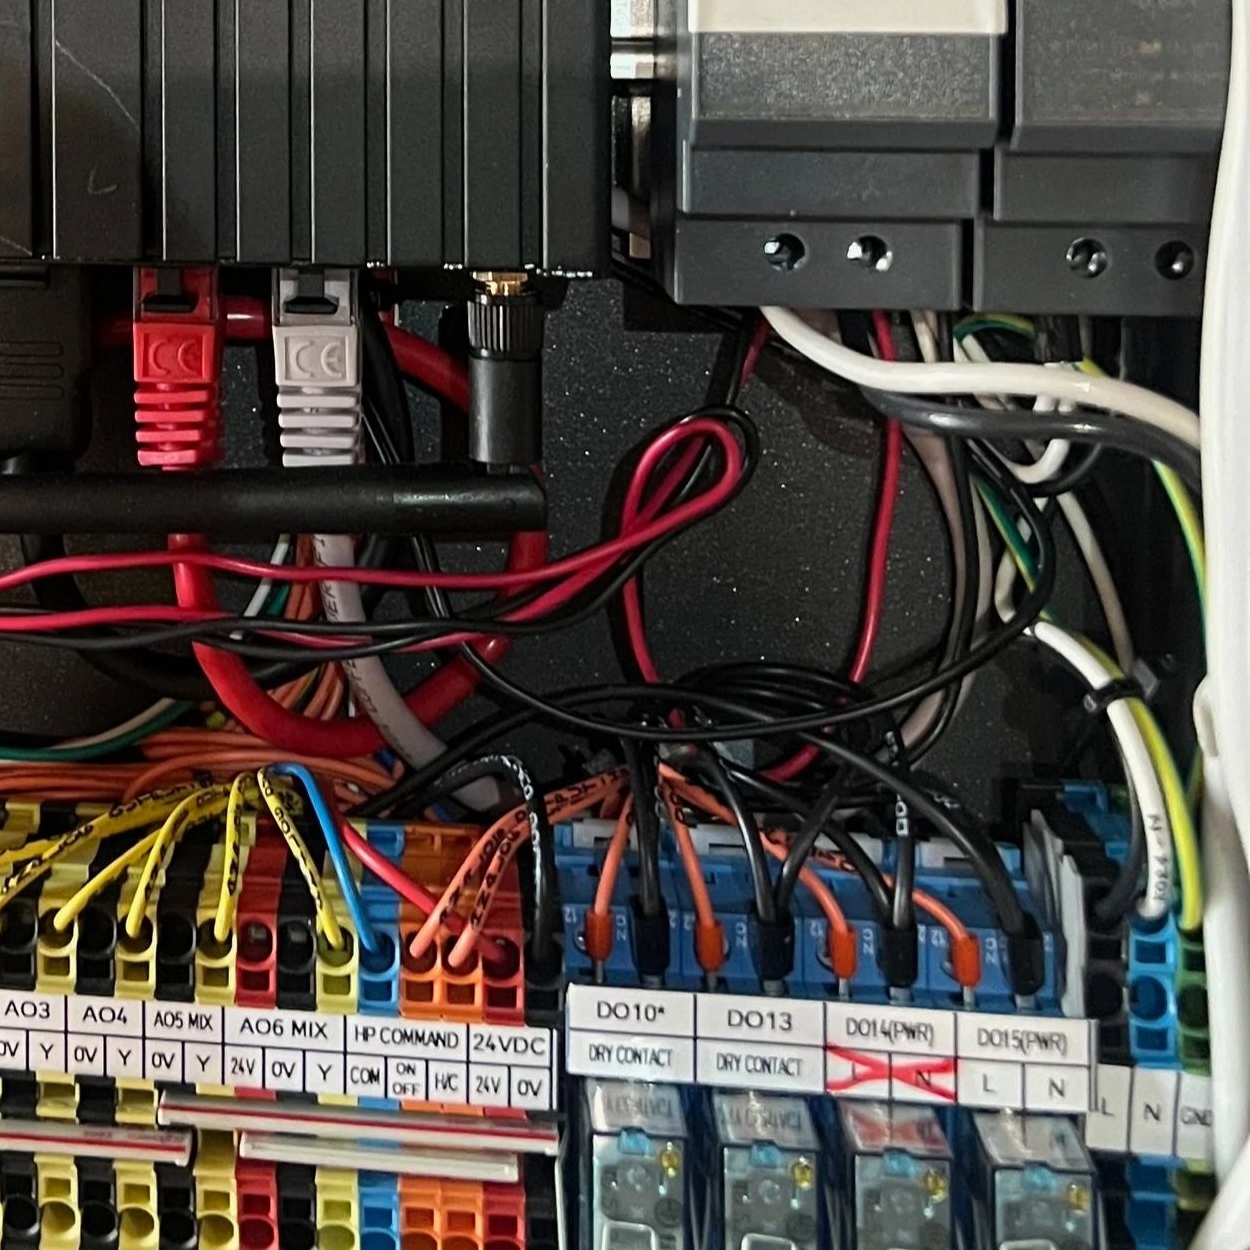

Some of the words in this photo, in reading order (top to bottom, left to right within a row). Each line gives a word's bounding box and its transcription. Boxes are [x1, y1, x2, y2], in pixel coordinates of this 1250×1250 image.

[294, 341, 343, 378] CE
[4, 1000, 50, 1019] AO3
[82, 1006, 128, 1025] AO4
[154, 1011, 184, 1029] AO5
[187, 1013, 214, 1031] MIX
[240, 1017, 284, 1036] AO6
[291, 1020, 328, 1039] MIX
[727, 1009, 793, 1031] DO13
[354, 1026, 375, 1043] HP
[379, 1028, 460, 1049] COMMAND
[846, 1018, 934, 1047] DO14(PWR)
[977, 1028, 1068, 1055] DO15(PWR)
[40, 1043, 54, 1060] Y
[473, 1034, 546, 1055] 24VDC
[74, 1046, 98, 1063] 0V
[118, 1049, 132, 1066] Y
[152, 1052, 176, 1069] 0V
[197, 1055, 211, 1071] Y
[589, 1043, 614, 1064] DRY
[617, 1045, 673, 1067] CONTACT
[231, 1057, 255, 1076] 24V
[272, 1061, 296, 1079] 0V
[319, 1064, 333, 1081] Y
[396, 1062, 417, 1075] ON
[716, 1052, 741, 1072] DRY
[745, 1055, 803, 1077] CONTACT
[351, 1067, 381, 1085] COM
[475, 1076, 501, 1094] 24V
[915, 1069, 931, 1088] N
[983, 1074, 997, 1093] L
[392, 1081, 419, 1095] OFF
[518, 1079, 542, 1098] 0V
[1049, 1078, 1065, 1098] N
[1102, 1097, 1114, 1116] L
[1144, 1103, 1160, 1122] N
